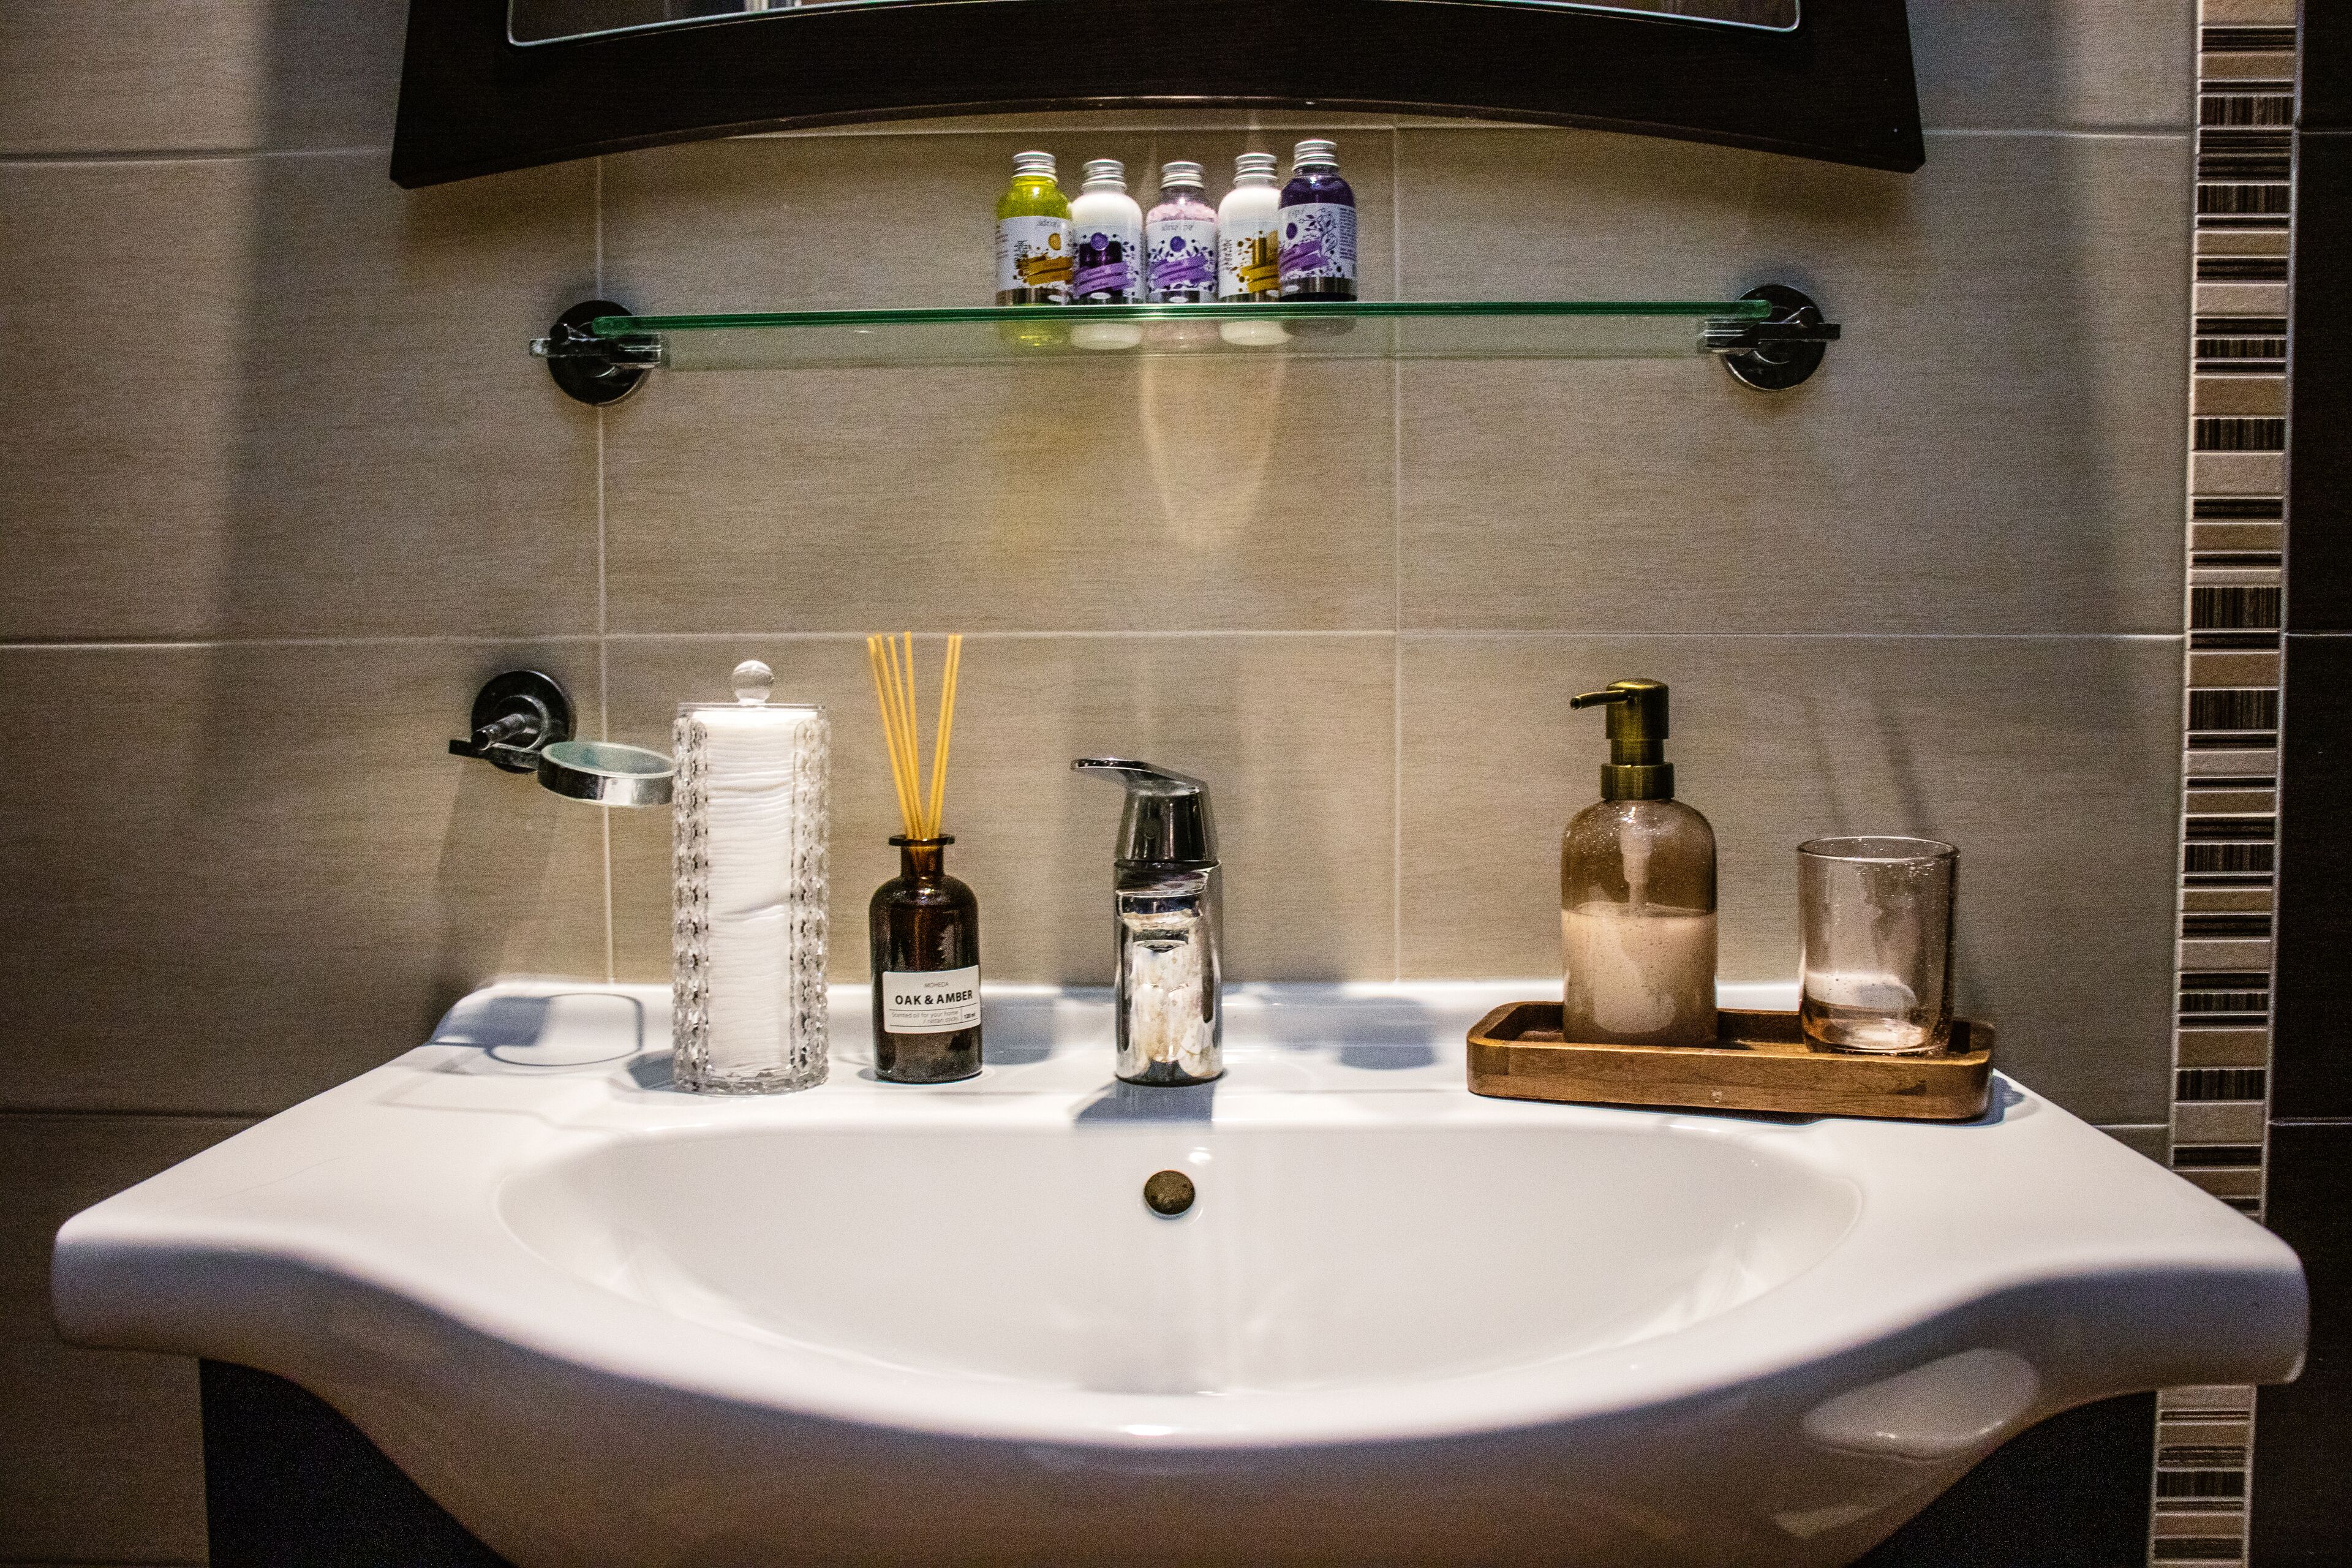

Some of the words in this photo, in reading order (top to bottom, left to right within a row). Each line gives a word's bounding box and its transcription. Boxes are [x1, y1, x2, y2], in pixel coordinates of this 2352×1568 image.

[895, 995, 921, 1005] OAK
[924, 995, 933, 1005] &
[937, 990, 973, 1004] AMBER
